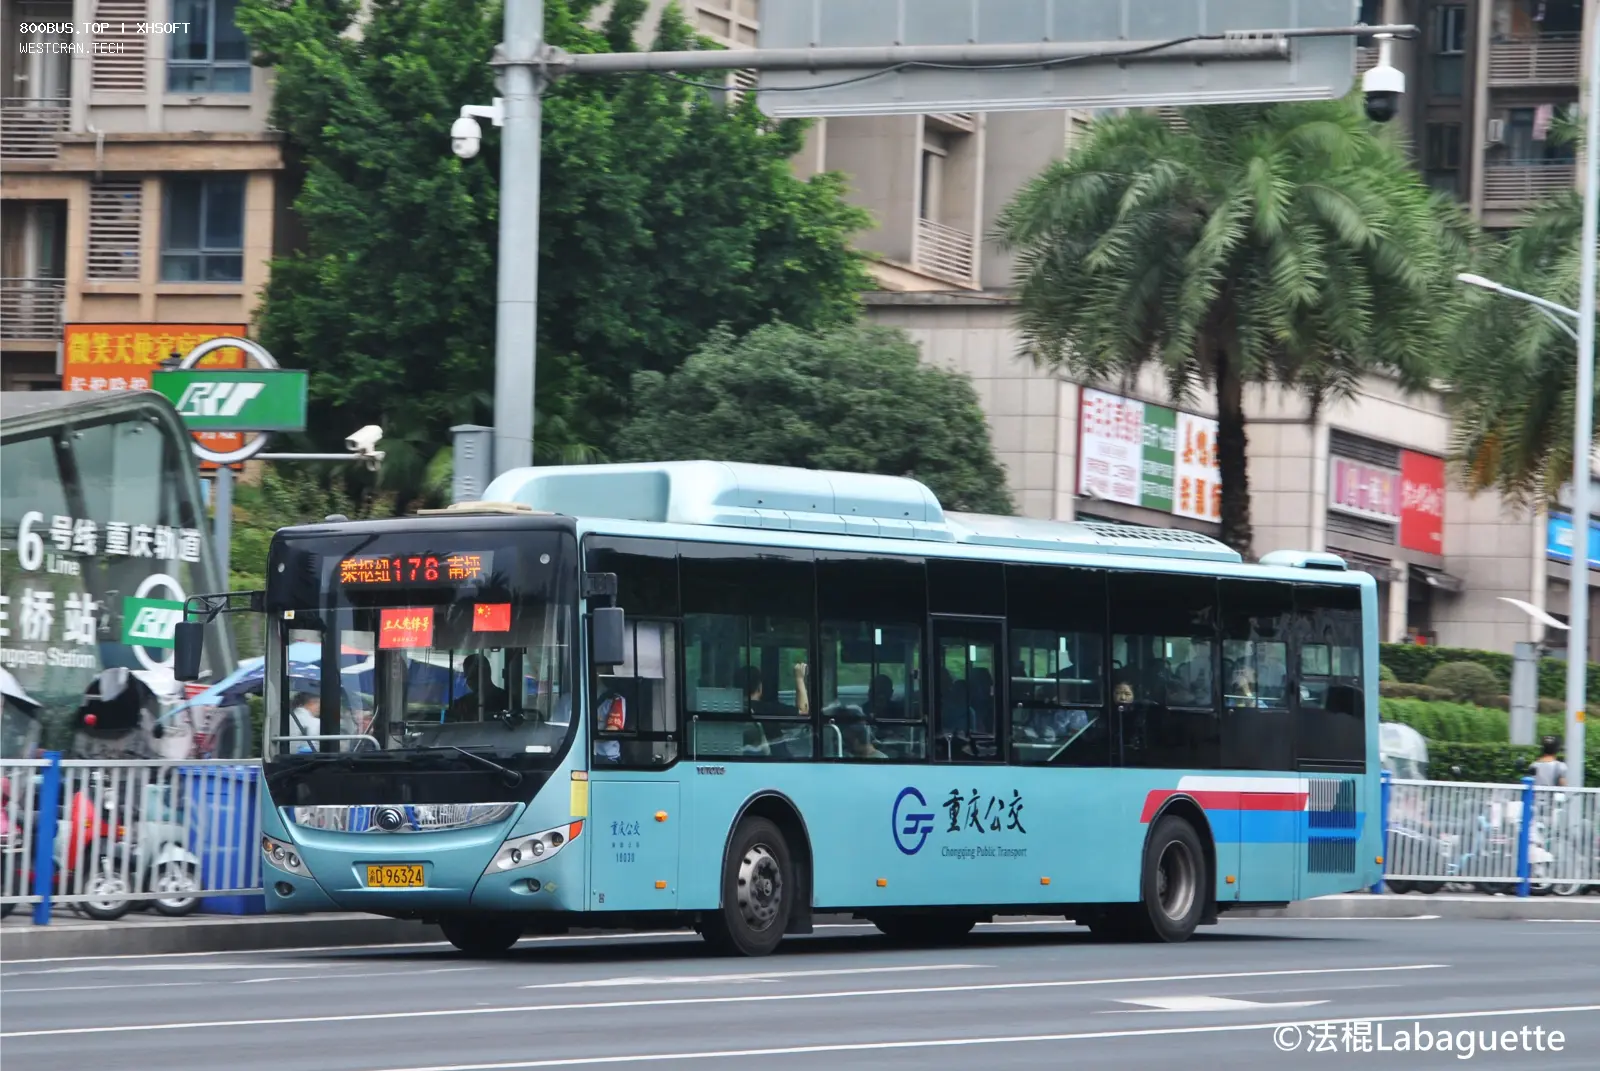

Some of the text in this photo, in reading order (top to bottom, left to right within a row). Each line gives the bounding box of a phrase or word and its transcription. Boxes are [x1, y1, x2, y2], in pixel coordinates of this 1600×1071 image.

[17, 510, 201, 571] 6 号线 重庆轨道
[46, 553, 81, 576] Line
[447, 554, 482, 580] 南坪
[47, 646, 97, 669] Station
[942, 788, 1027, 834] 重庆公交
[610, 820, 641, 836] 重庆公交
[941, 845, 1027, 860] Chongqing Public Transport
